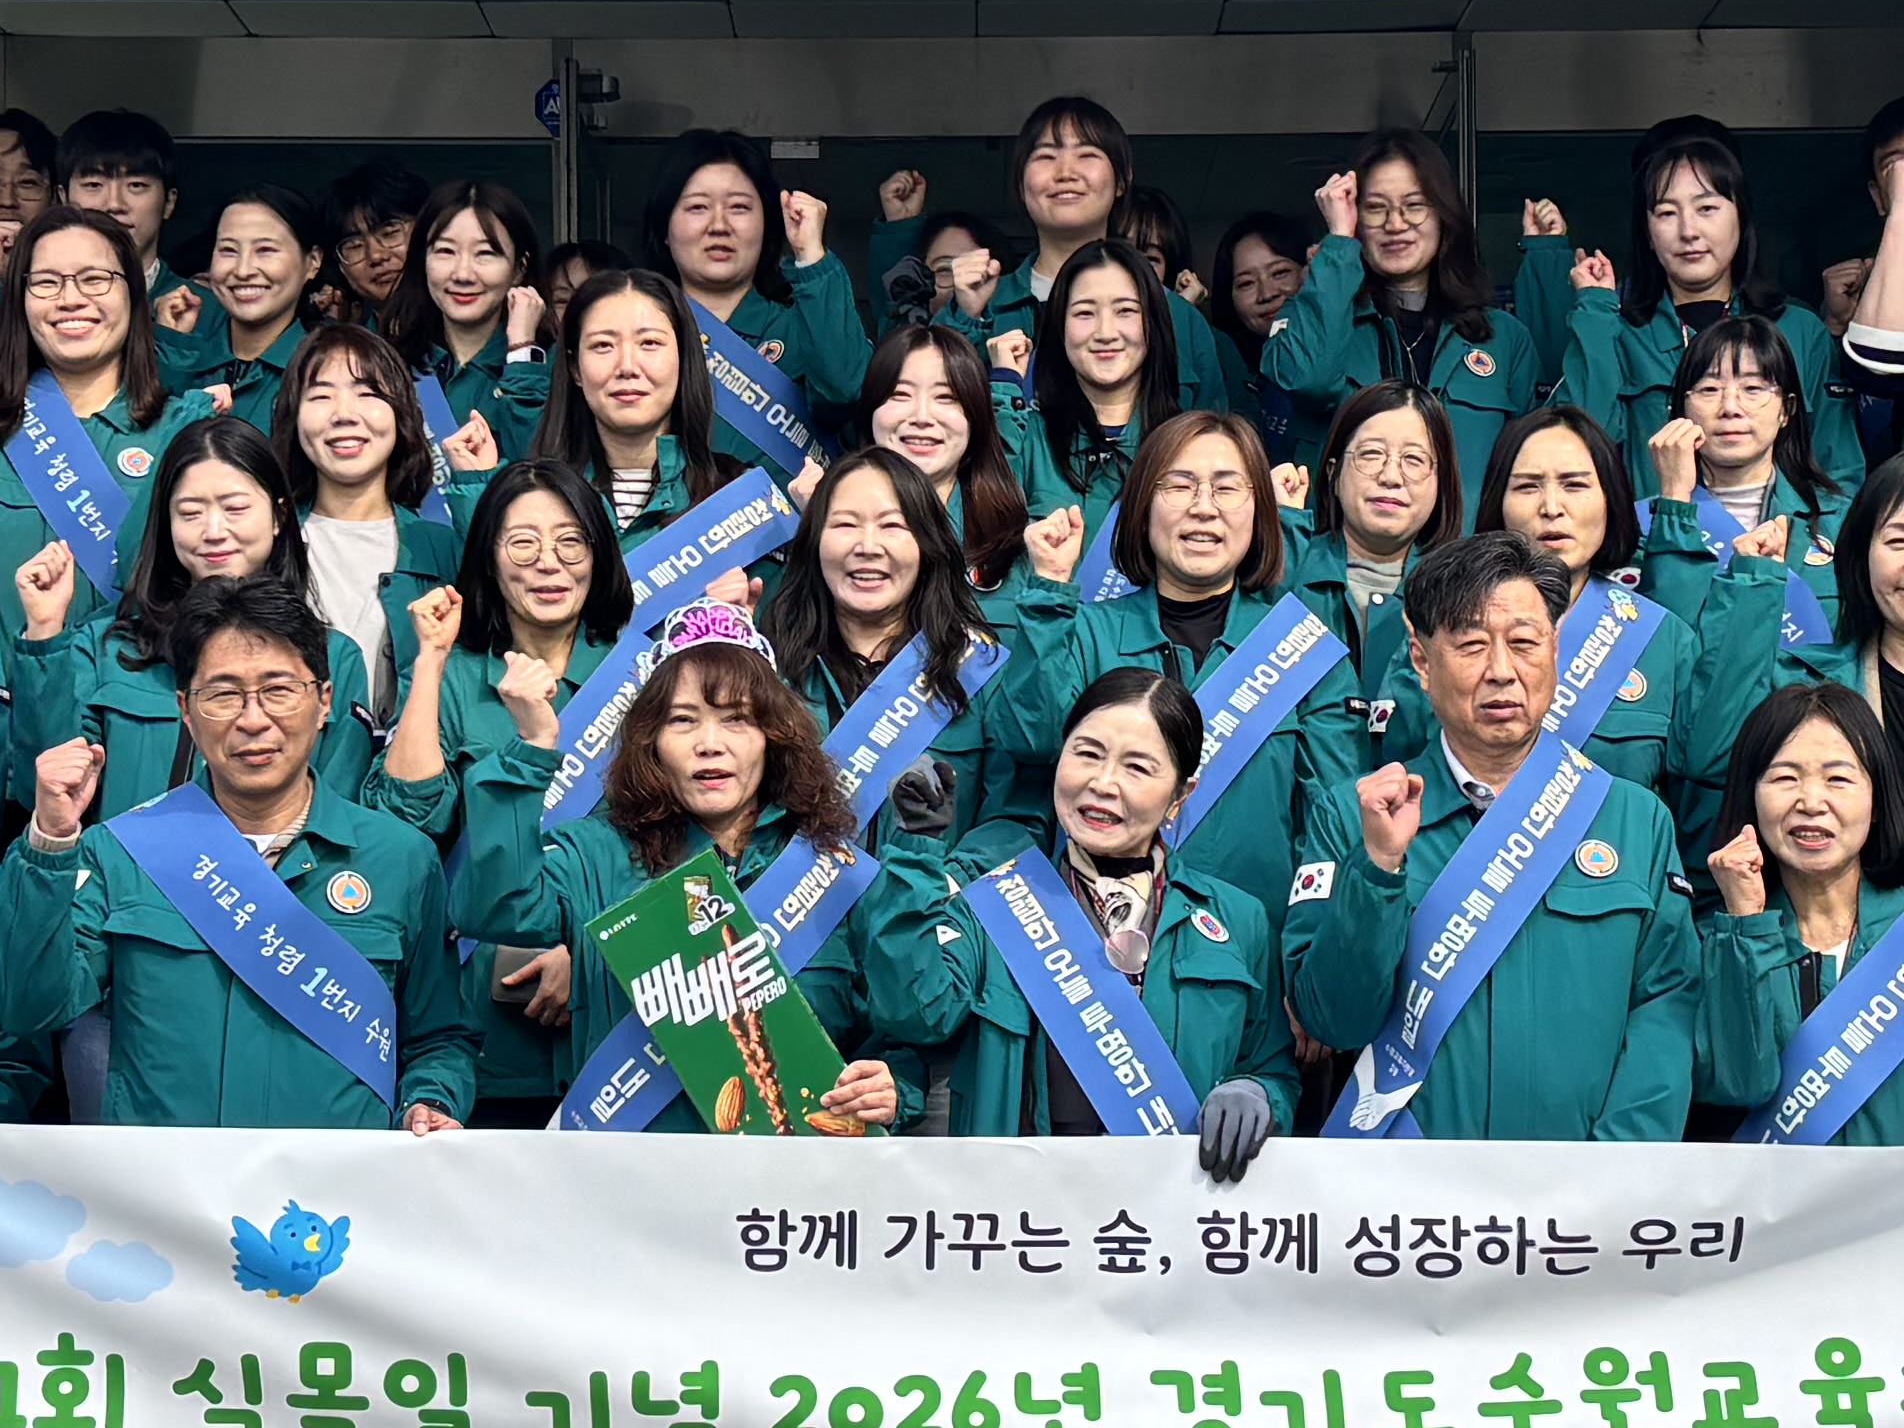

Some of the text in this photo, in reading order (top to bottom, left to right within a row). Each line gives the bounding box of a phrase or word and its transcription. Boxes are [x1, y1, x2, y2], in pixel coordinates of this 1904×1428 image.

[47, 452, 79, 493] 청렴
[66, 489, 112, 542] 1번지
[1564, 611, 1623, 689] 청렴한
[1228, 662, 1280, 715] 오늘
[1522, 761, 1580, 840] 청렴한
[1481, 834, 1534, 894] 오늘
[191, 853, 258, 932] 경기교육
[258, 923, 306, 975] 청렴
[300, 965, 362, 1024] 1번지
[698, 897, 730, 924] 12
[1421, 888, 1495, 982] 투명한
[630, 930, 776, 1028] 빼빼로
[742, 976, 788, 1013] PEPERO
[995, 874, 1061, 952] 청렴한
[1044, 948, 1094, 1005] 오늘
[1079, 1000, 1153, 1099] 투명한
[1400, 978, 1434, 1050] 내일
[1840, 993, 1899, 1055] 오늘
[590, 1056, 652, 1124] 내일
[1774, 1044, 1853, 1134] 투명한
[734, 1206, 1745, 1280] 함께 가꾸는 숲, 함께 성장하는 우리
